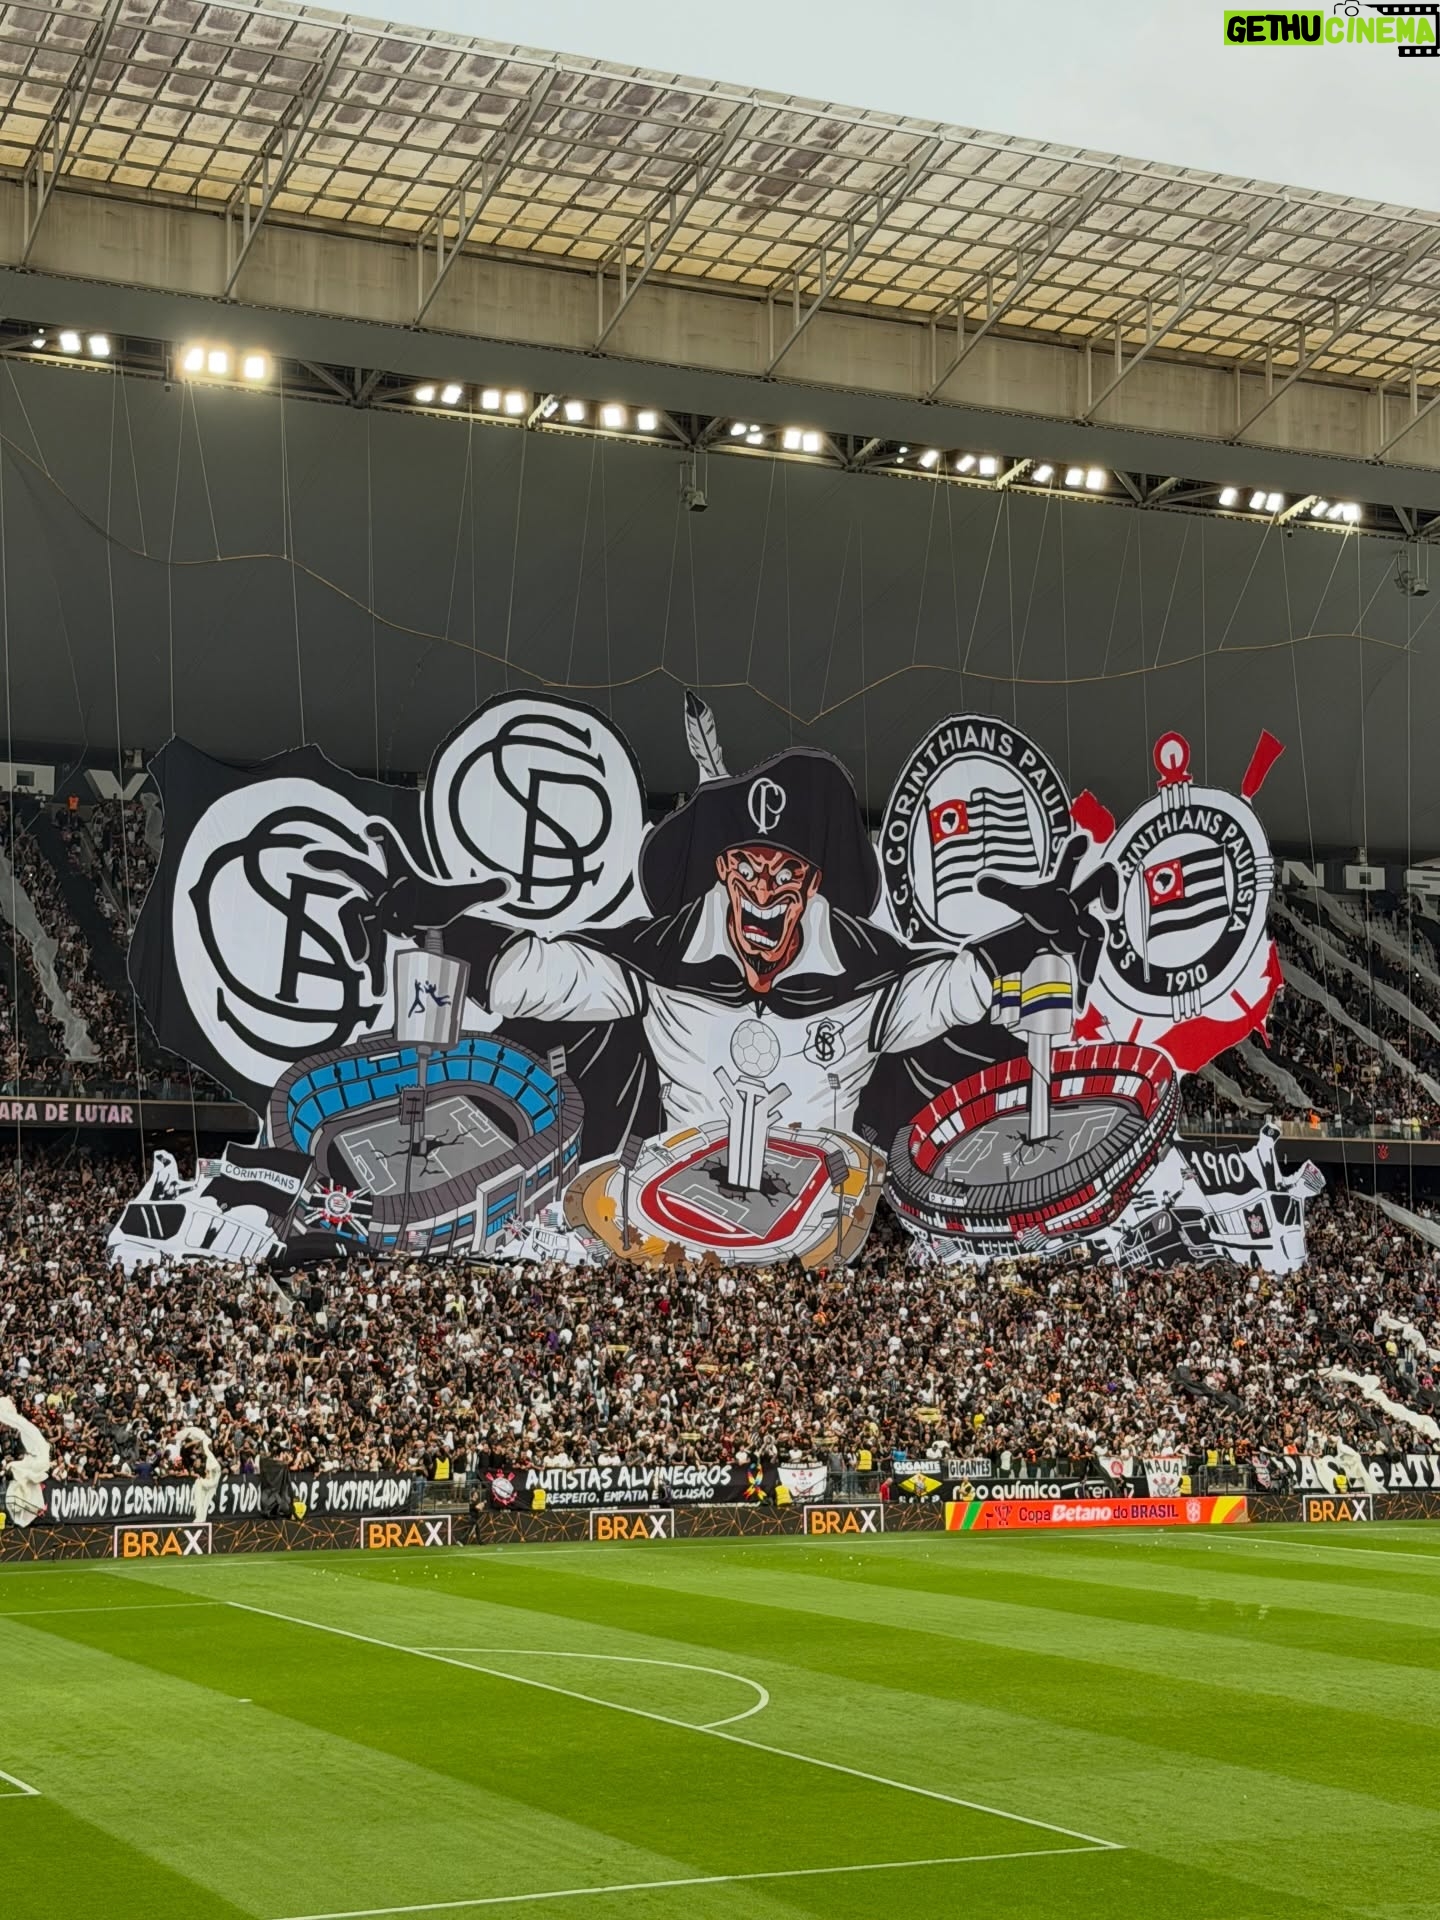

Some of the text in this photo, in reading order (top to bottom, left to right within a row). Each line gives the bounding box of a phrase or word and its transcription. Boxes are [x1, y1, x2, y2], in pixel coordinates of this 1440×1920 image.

[886, 725, 1014, 866] CORINTHIANS
[1120, 809, 1223, 879] RINTHIANS
[1221, 823, 1254, 932] PAULISTA
[1165, 964, 1208, 993] 1910
[45, 1104, 69, 1121] DE
[75, 1104, 134, 1123] LUTAR
[225, 1163, 295, 1190] CORINTHIANS
[1189, 1151, 1245, 1187] 1910
[526, 1467, 613, 1491] AUTISTAS
[950, 1462, 990, 1475] GIGANTES
[51, 1485, 108, 1521] QUANDO
[111, 1486, 122, 1516] O
[231, 1482, 262, 1514] TUD
[603, 1490, 648, 1502] EMPATIA
[991, 1480, 1061, 1501] química
[811, 1509, 877, 1535] BRAX
[1019, 1504, 1179, 1523] Copa Betano do BRASIL
[1309, 1499, 1367, 1522] BRAX
[369, 1521, 443, 1549] BRAX
[598, 1514, 668, 1540] BRAX
[124, 1529, 203, 1558] BRAX
